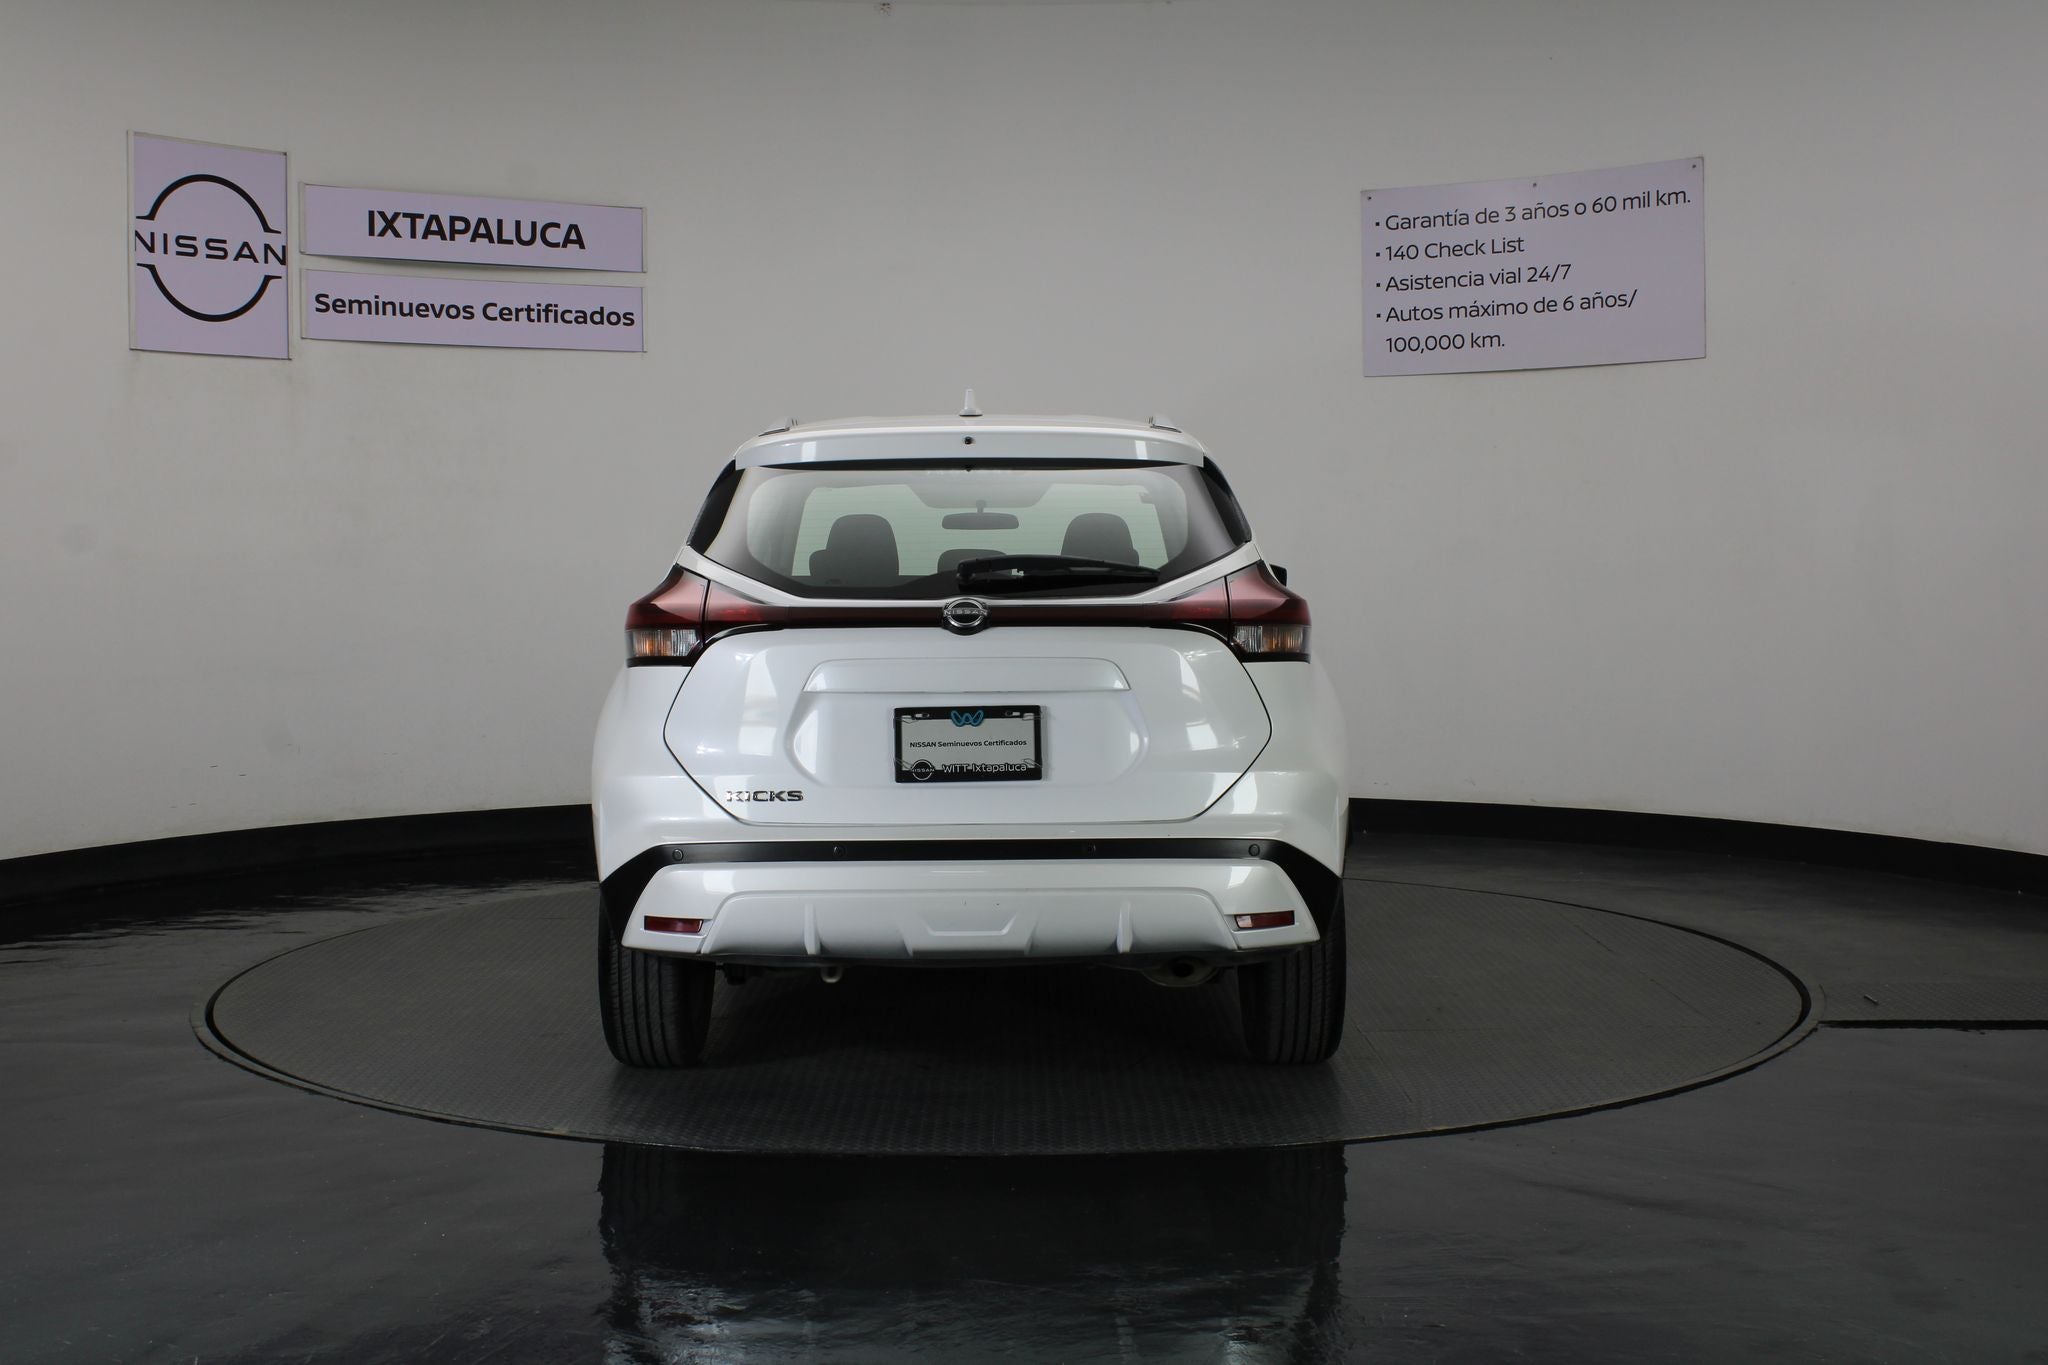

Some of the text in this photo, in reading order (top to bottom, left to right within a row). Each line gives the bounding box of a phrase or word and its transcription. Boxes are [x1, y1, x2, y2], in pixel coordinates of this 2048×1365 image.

[1385, 189, 1691, 231] Garantía de 3 años o 60 mil km.
[367, 209, 586, 250] IXTAPALUCA
[134, 229, 287, 266] NISSAN
[1385, 236, 1525, 261] 140 Check List
[1385, 263, 1572, 292] Asistencia vial 24/7
[314, 293, 635, 328] Seminuevos Certificados
[1386, 289, 1637, 322] Autos máximo de 6 años/
[1386, 332, 1505, 354] 100,000 km.
[983, 739, 1027, 747] Certificados
[726, 790, 804, 802] KICKS
